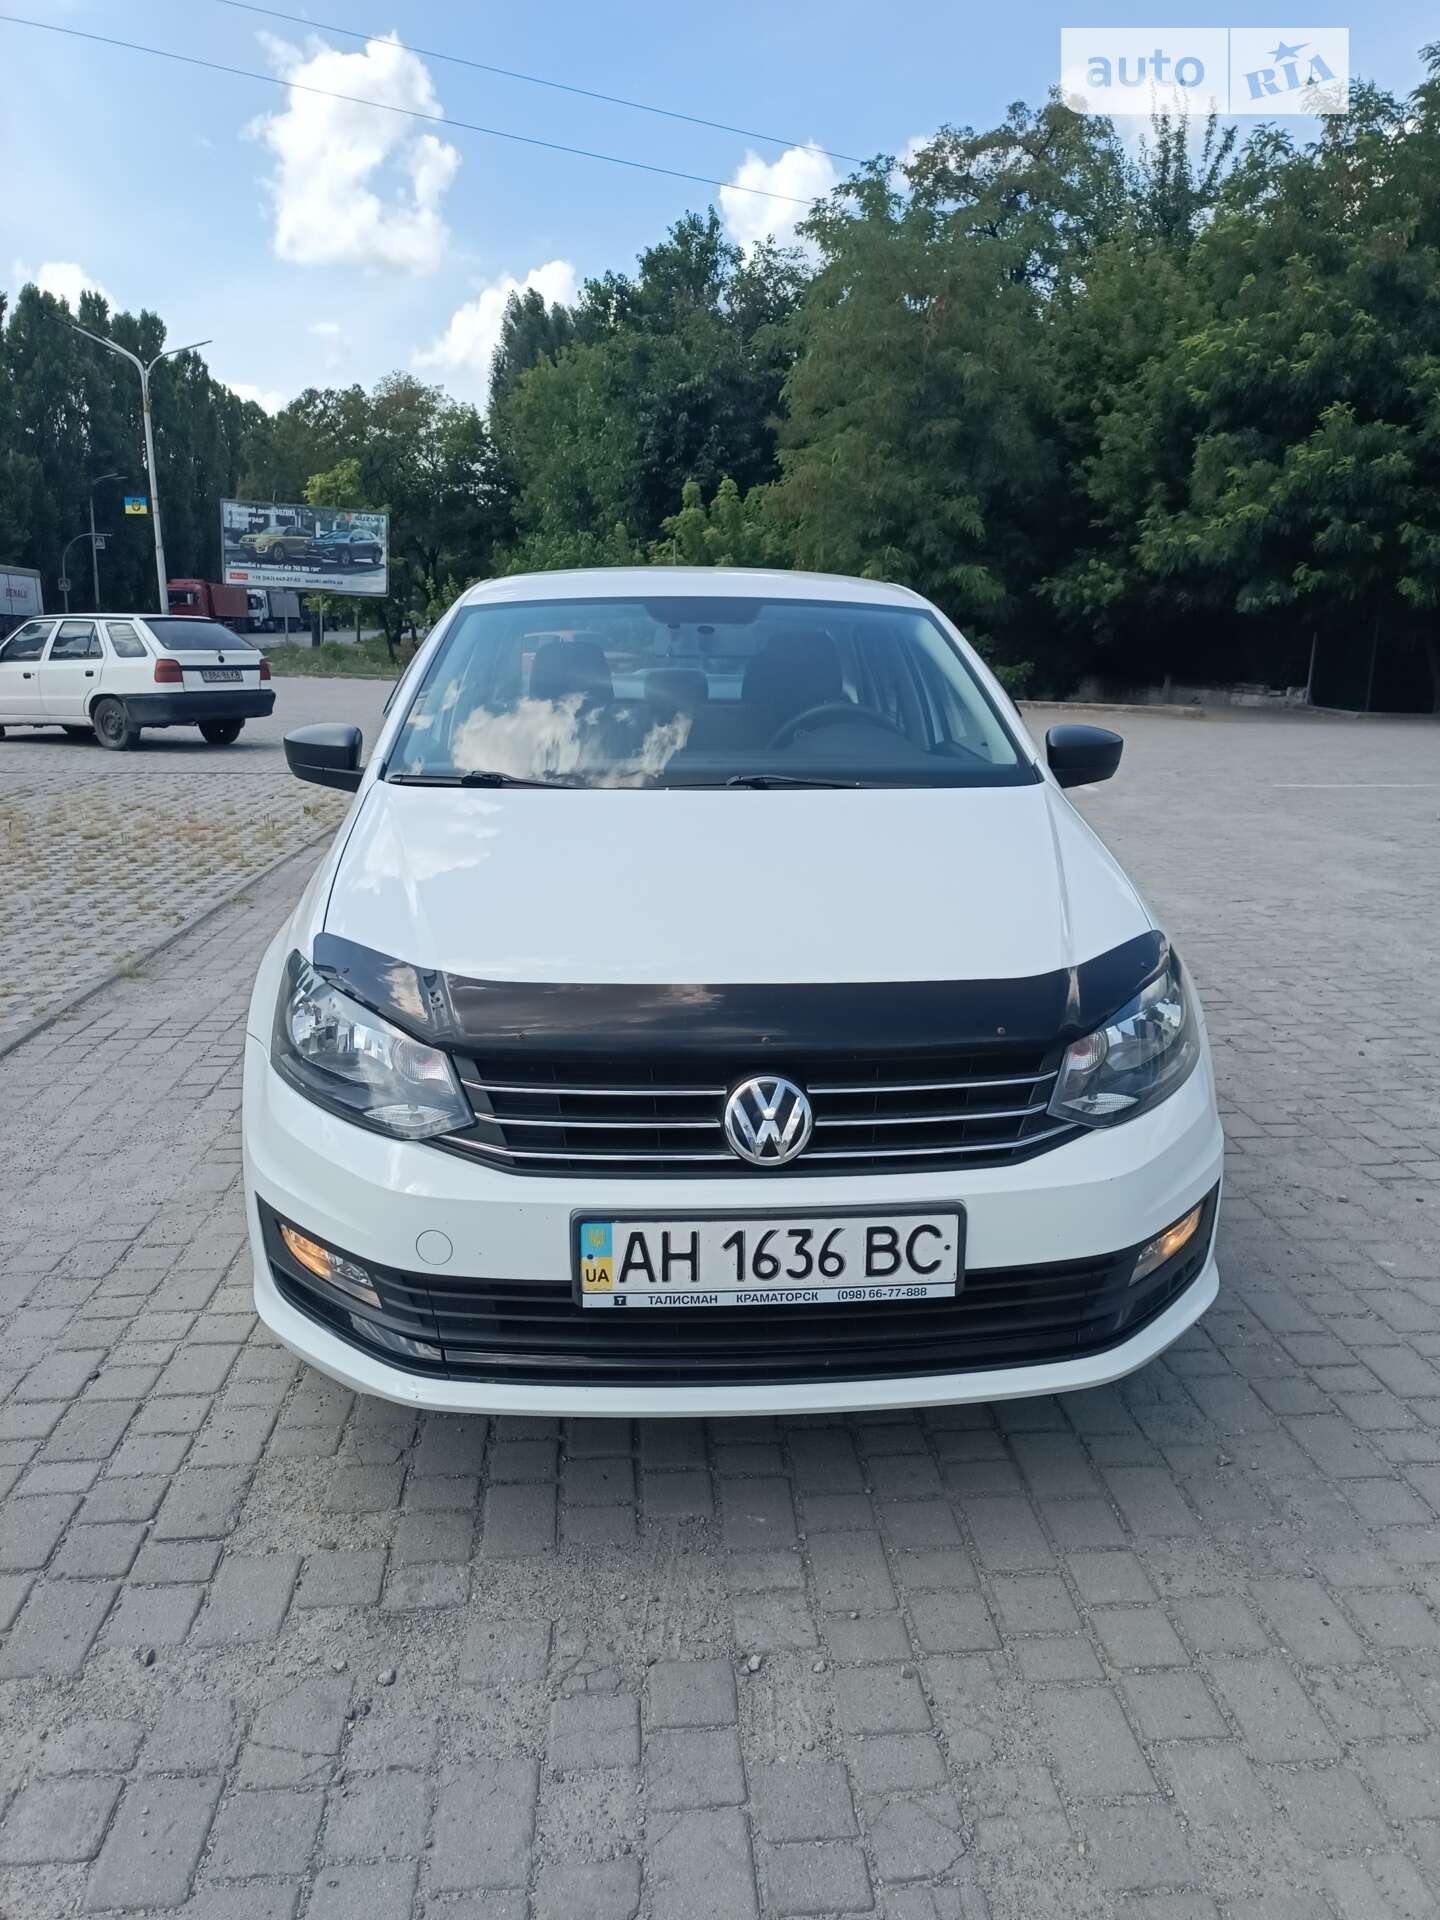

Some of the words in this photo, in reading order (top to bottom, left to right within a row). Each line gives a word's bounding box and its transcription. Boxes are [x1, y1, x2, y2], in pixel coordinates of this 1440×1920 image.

[619, 1230, 700, 1283] AH
[721, 1227, 846, 1281] 1636
[865, 1223, 943, 1278] BC
[586, 1268, 609, 1282] UA
[647, 1294, 718, 1305] ТАЛИСМАН
[736, 1292, 819, 1303] КРАМАТОРСК
[837, 1289, 866, 1301] (098)
[868, 1287, 928, 1299] 66-77-888
